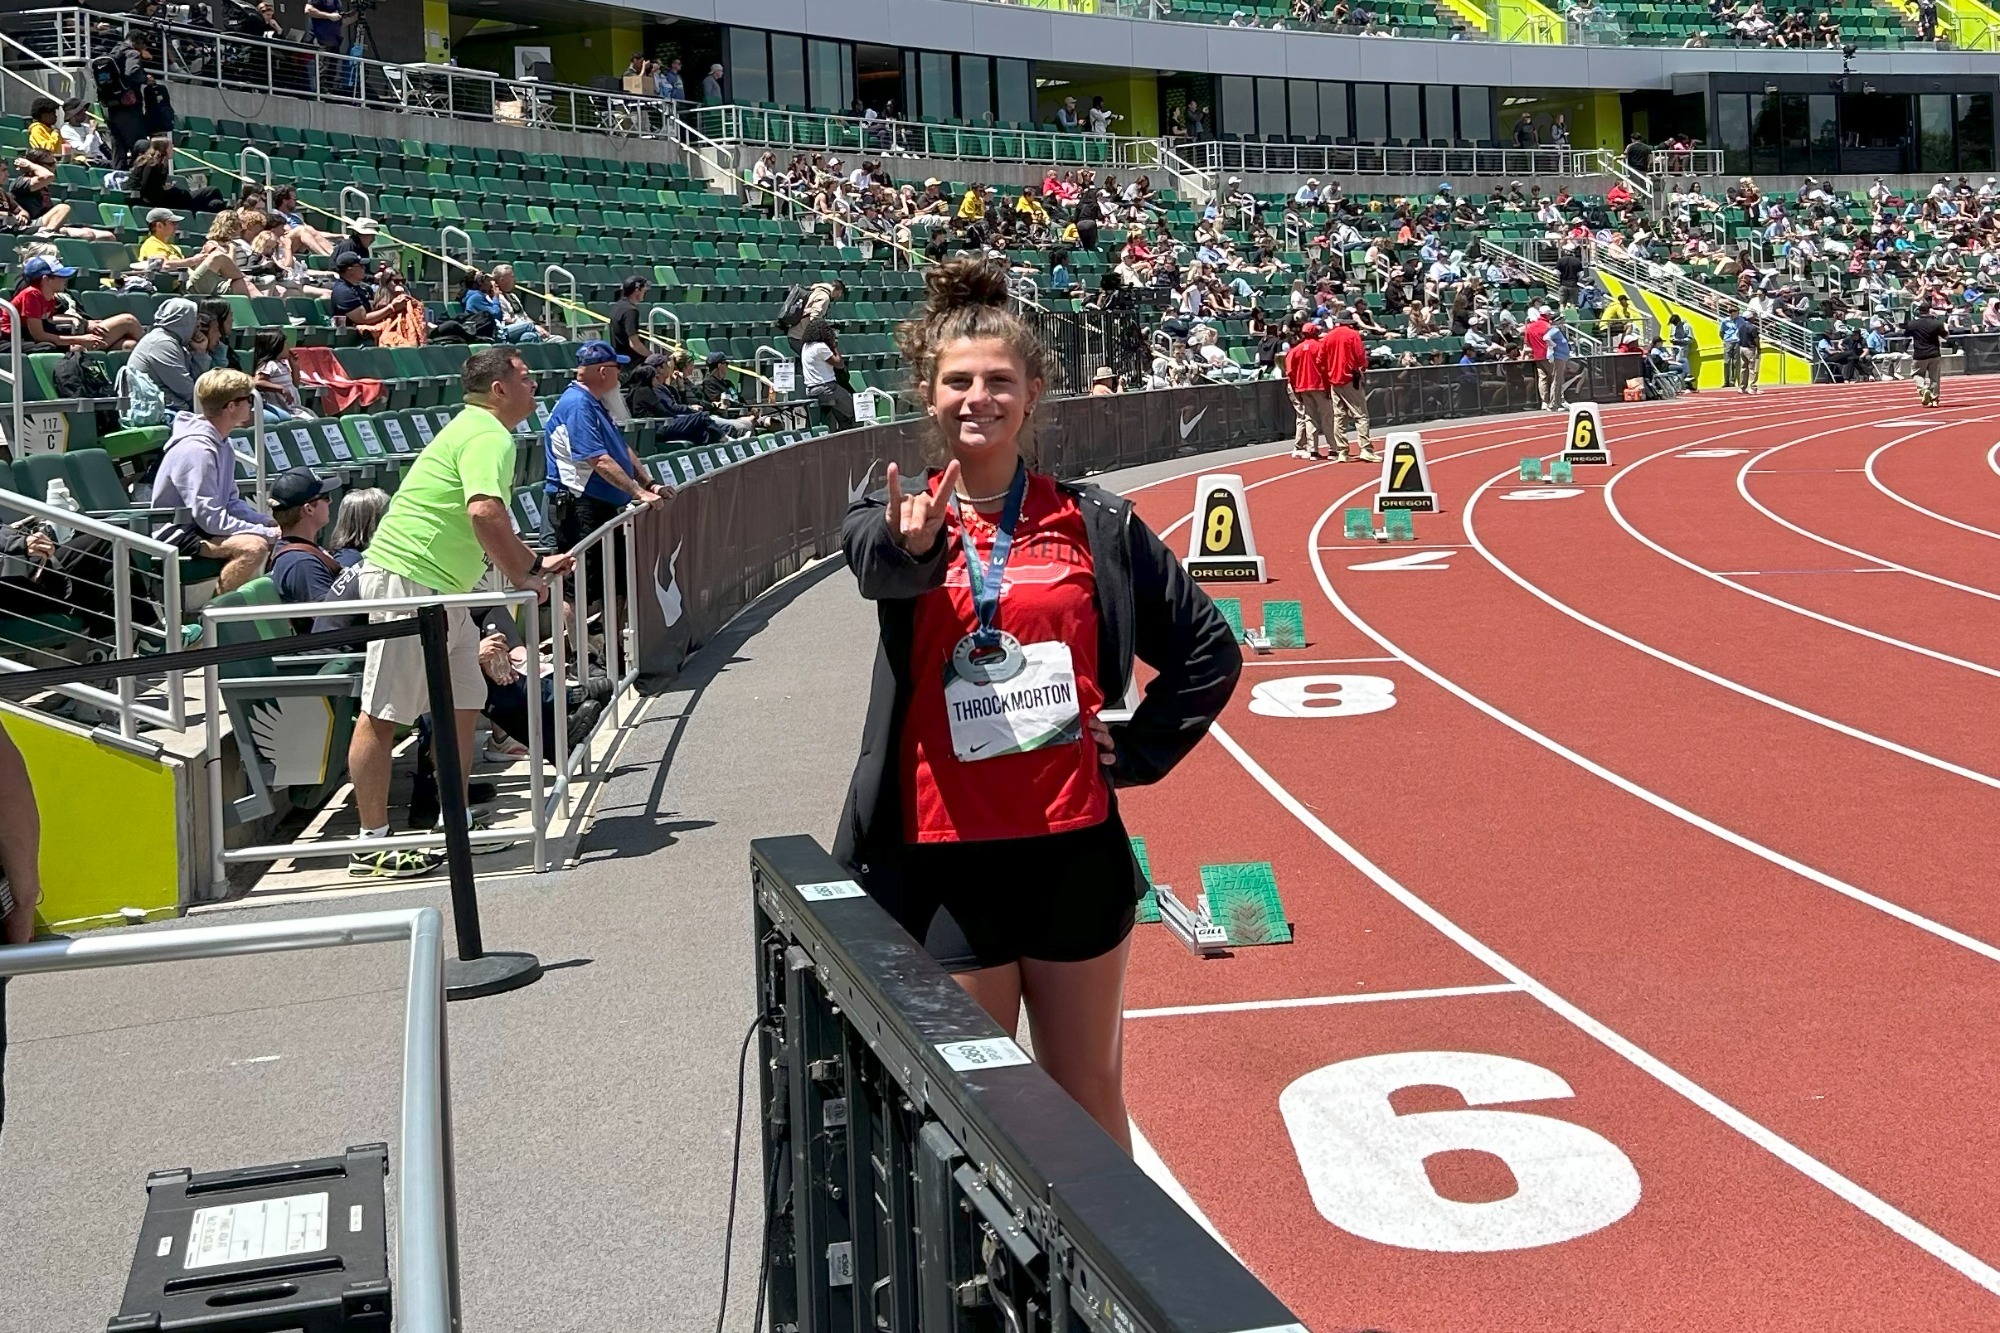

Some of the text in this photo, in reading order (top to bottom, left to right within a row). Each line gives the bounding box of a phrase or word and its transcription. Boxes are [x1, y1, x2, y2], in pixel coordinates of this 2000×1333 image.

[42, 417, 58, 430] 117
[1573, 419, 1593, 448] 6
[47, 434, 55, 450] C
[1391, 454, 1416, 489] 7
[1381, 499, 1431, 508] OREGON
[1205, 505, 1234, 552] 8
[1191, 569, 1256, 577] OREGON
[952, 682, 1072, 722] THROCKMORTON
[1248, 674, 1398, 718] 8
[1198, 928, 1223, 936] GILL
